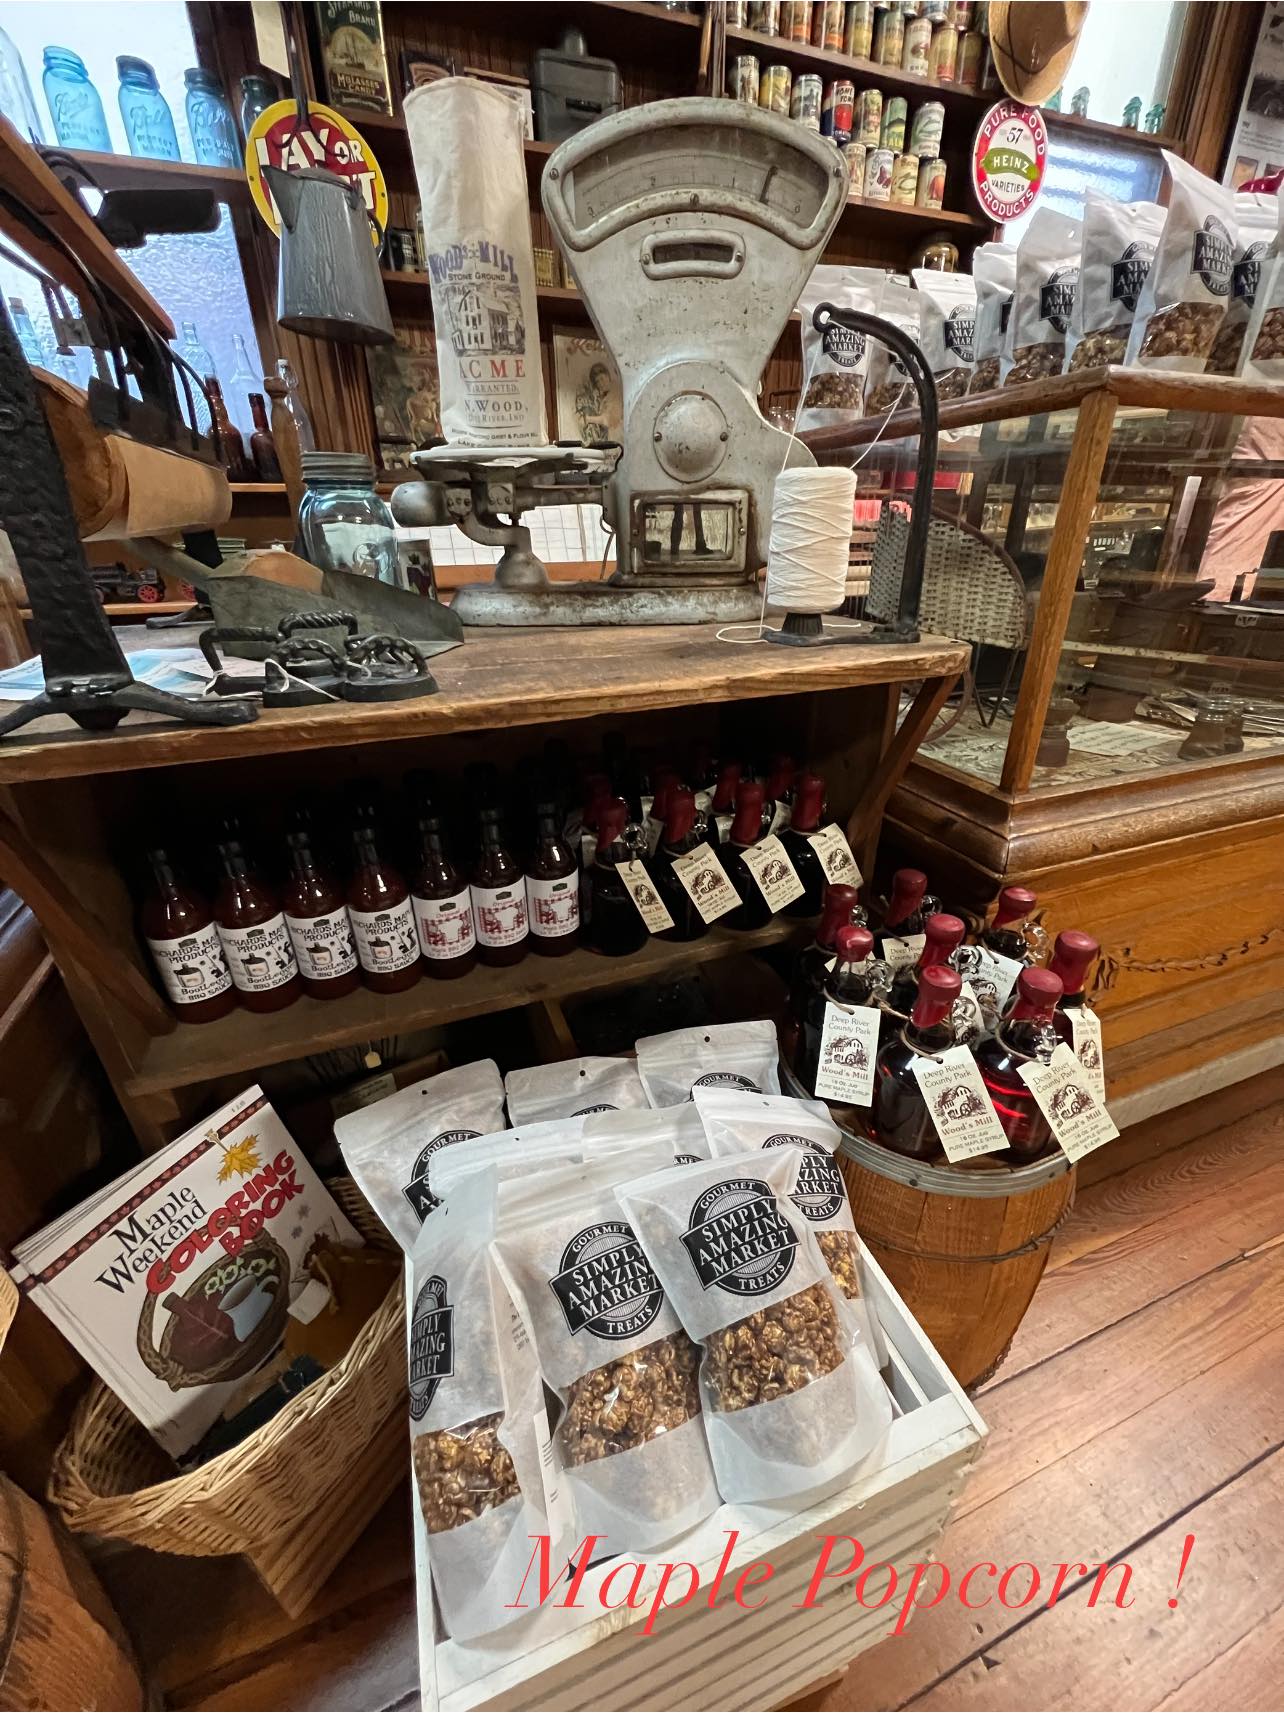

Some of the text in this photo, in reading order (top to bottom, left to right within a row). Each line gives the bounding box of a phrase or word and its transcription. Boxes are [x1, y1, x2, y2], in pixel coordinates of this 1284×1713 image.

[984, 106, 1046, 156] PURE FOOD
[1006, 127, 1024, 145] 57
[993, 156, 1030, 173] HEINZ
[991, 179, 1025, 194] VARIETIES
[980, 181, 1034, 217] PRODUCTS
[448, 271, 505, 281] STONE GROUND
[949, 329, 974, 337] AMAZ
[953, 320, 975, 329] SIMP
[829, 342, 863, 353] MARKET
[303, 925, 348, 942] PRODUCTS
[365, 918, 409, 936] PRODUCTS
[168, 942, 220, 965] PRODUCTS
[236, 933, 285, 953] PRODUCTS
[828, 1023, 871, 1035] County Park
[832, 1014, 869, 1027] Deep River
[701, 1074, 740, 1087] GOURMET
[821, 1065, 868, 1081] Wood's Mill
[923, 1063, 966, 1080] Deep River
[924, 1070, 972, 1089] County Park
[1032, 1062, 1070, 1085] Deep River
[1036, 1067, 1077, 1094] County Park
[941, 1115, 994, 1137] Wood's Mill
[1057, 1109, 1102, 1138] Wood's Mill
[422, 1133, 471, 1162] GOURMET
[770, 1136, 813, 1148] GOURMET
[801, 1156, 828, 1168] PLY
[700, 1182, 755, 1210] GOURMET
[218, 1168, 305, 1258] BOOK
[797, 1202, 834, 1216] TREATS
[107, 1187, 197, 1257] Maple
[146, 1149, 295, 1294] COLORING
[702, 1199, 773, 1242] SIMPLY
[94, 1199, 209, 1294] Weekend
[572, 1225, 628, 1253] GOURMET
[699, 1213, 788, 1266] AMAZING
[711, 1229, 790, 1277] MARKET
[568, 1258, 649, 1310] AMAZIN
[738, 1261, 785, 1290] TREATS
[580, 1273, 659, 1320] MARKET
[607, 1304, 653, 1333] TREATS
